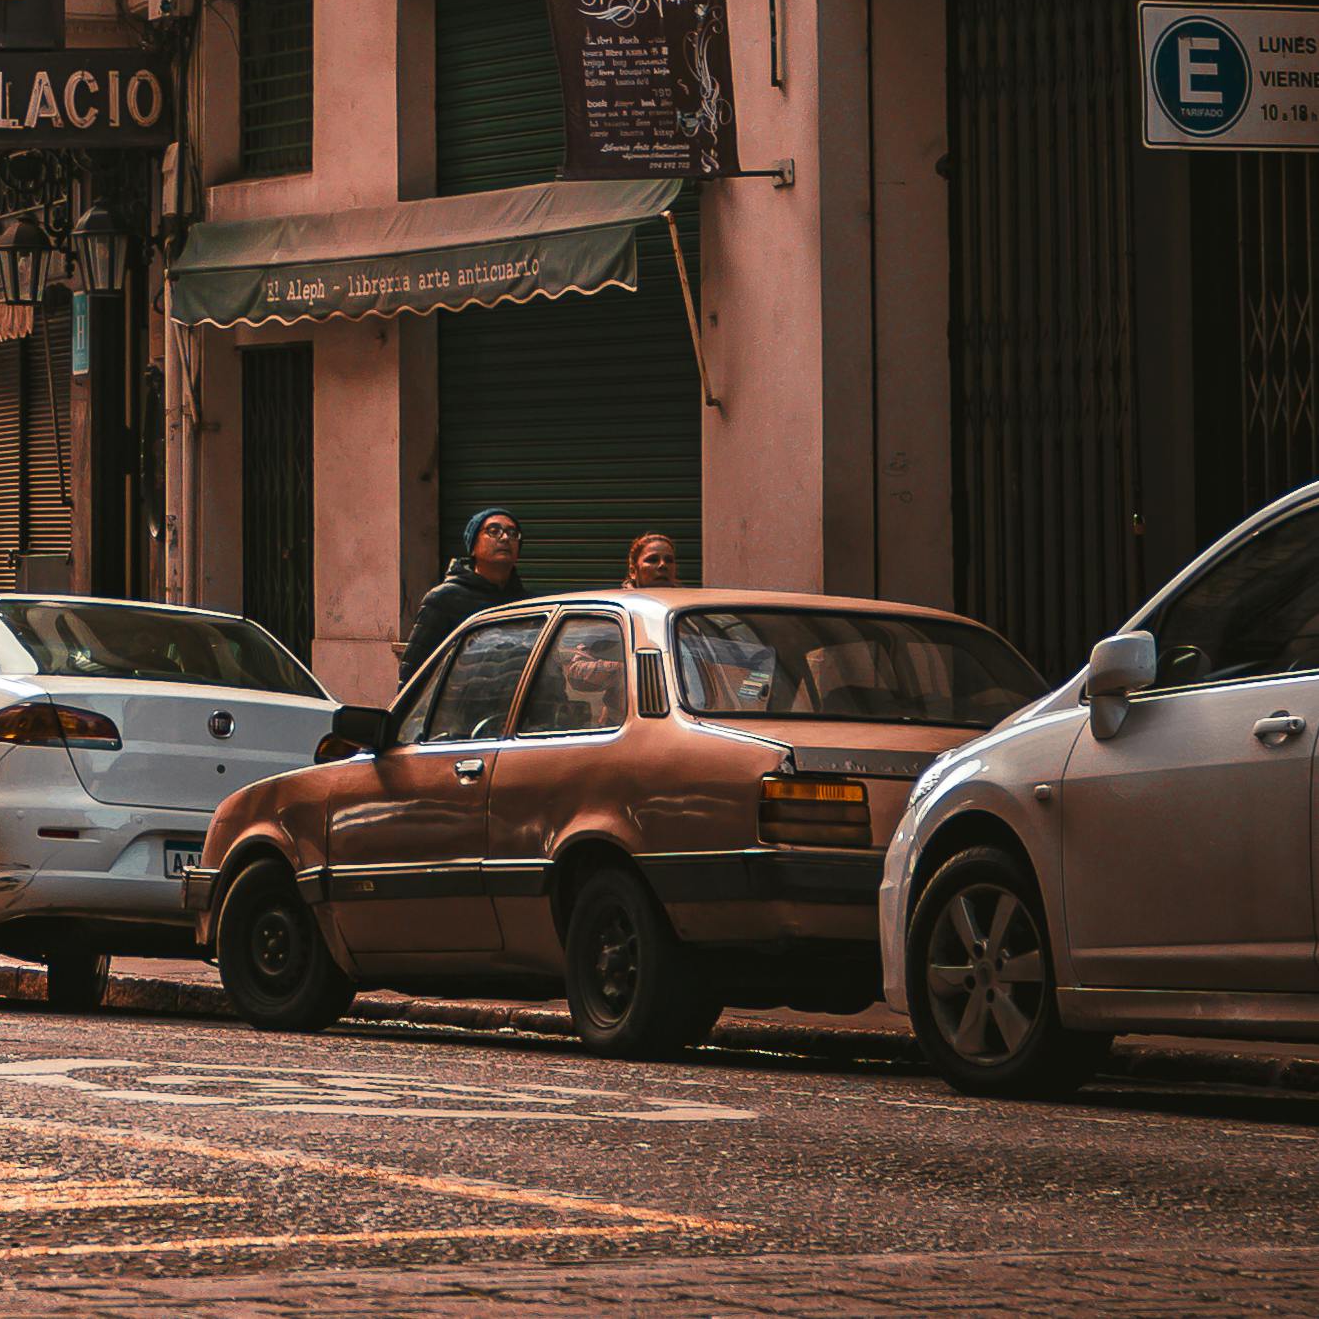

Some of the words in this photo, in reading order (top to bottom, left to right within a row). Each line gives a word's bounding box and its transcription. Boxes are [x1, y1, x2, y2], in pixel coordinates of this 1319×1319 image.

[1259, 35, 1317, 54] LUNES
[1178, 37, 1223, 104] E
[1180, 107, 1224, 118] TARIFADO
[1260, 104, 1279, 121] 10
[287, 278, 325, 305] Aleph
[418, 267, 450, 290] arte
[457, 254, 540, 286] anticuario
[173, 853, 203, 871] AA
